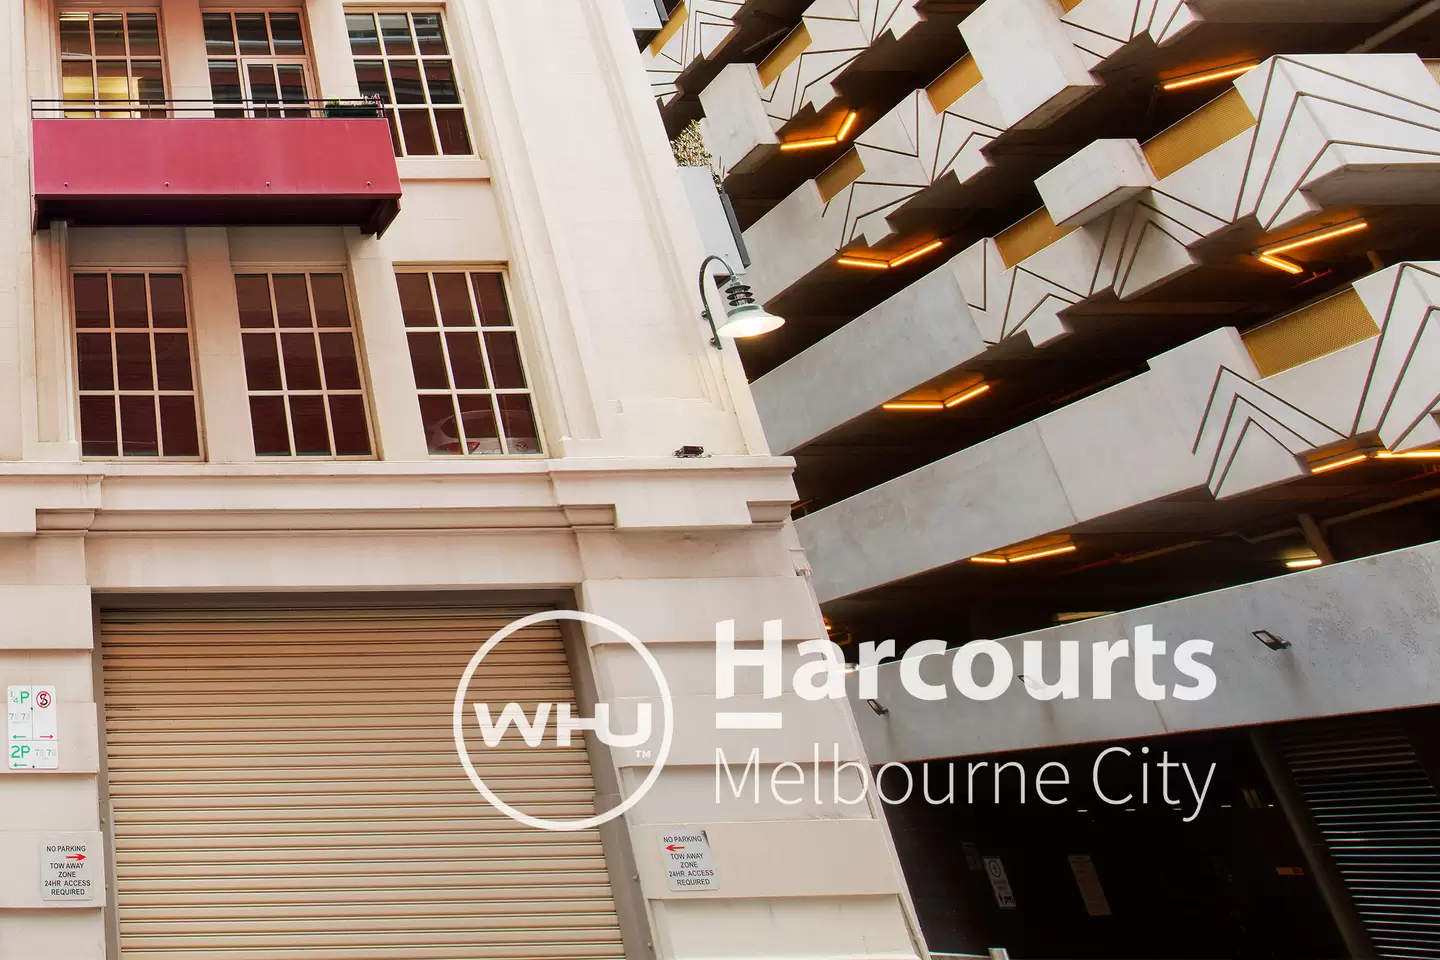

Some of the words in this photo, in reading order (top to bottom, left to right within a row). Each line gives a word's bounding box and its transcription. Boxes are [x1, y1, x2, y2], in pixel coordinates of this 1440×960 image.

[11, 745, 31, 759] 2P
[688, 869, 714, 877] ACCESS
[64, 879, 91, 887] ACCESS
[677, 878, 710, 886] REQUIRED
[51, 888, 85, 896] REQUIRED
